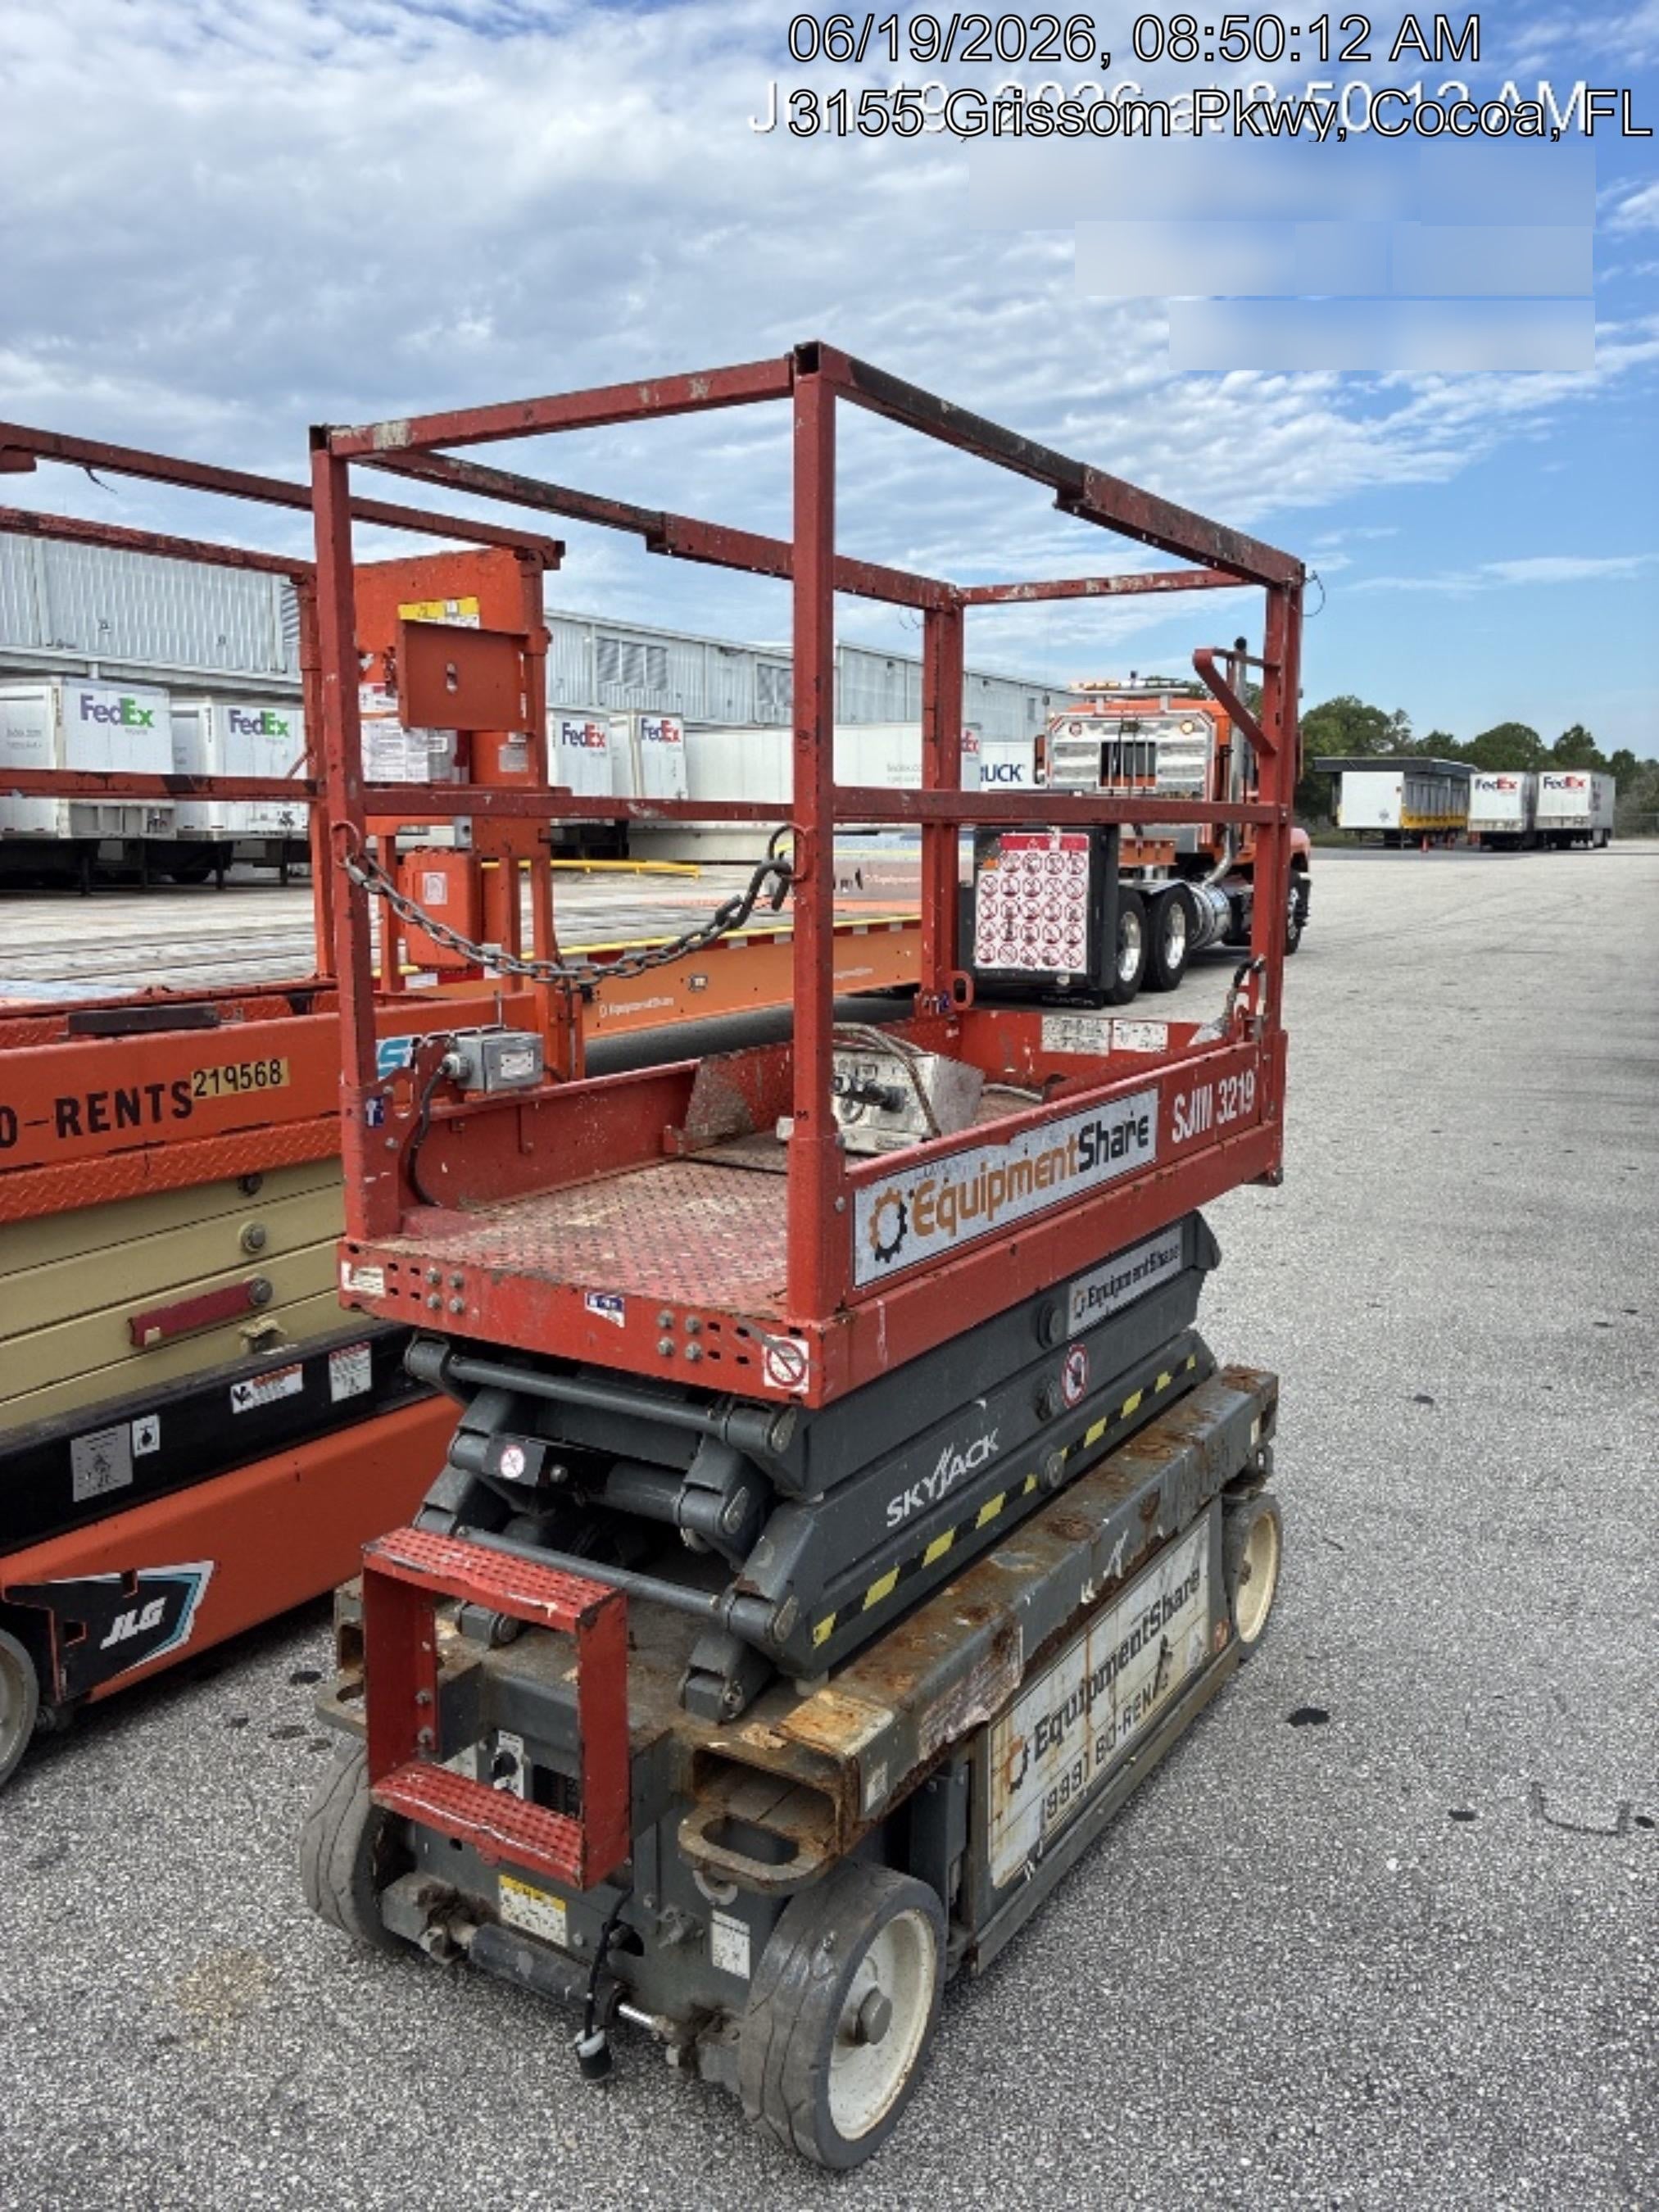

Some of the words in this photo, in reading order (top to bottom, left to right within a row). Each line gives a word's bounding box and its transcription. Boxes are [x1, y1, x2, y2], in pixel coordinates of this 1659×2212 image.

[79, 694, 155, 728] FedEx
[229, 709, 290, 737] FedEx
[641, 718, 681, 743] FedEx
[562, 722, 606, 748] FedEx
[1475, 777, 1517, 791] FedEx
[1543, 776, 1586, 790] FedEx
[193, 1058, 282, 1097] 219568
[1216, 1068, 1256, 1125] 3219
[912, 1113, 1150, 1238] EquipmentShare
[1088, 1244, 1180, 1309] EquipmentShare
[886, 1427, 999, 1527] SKYJACK
[99, 1596, 167, 1651] JLG
[1034, 1566, 1201, 1763] EquipmentShare
